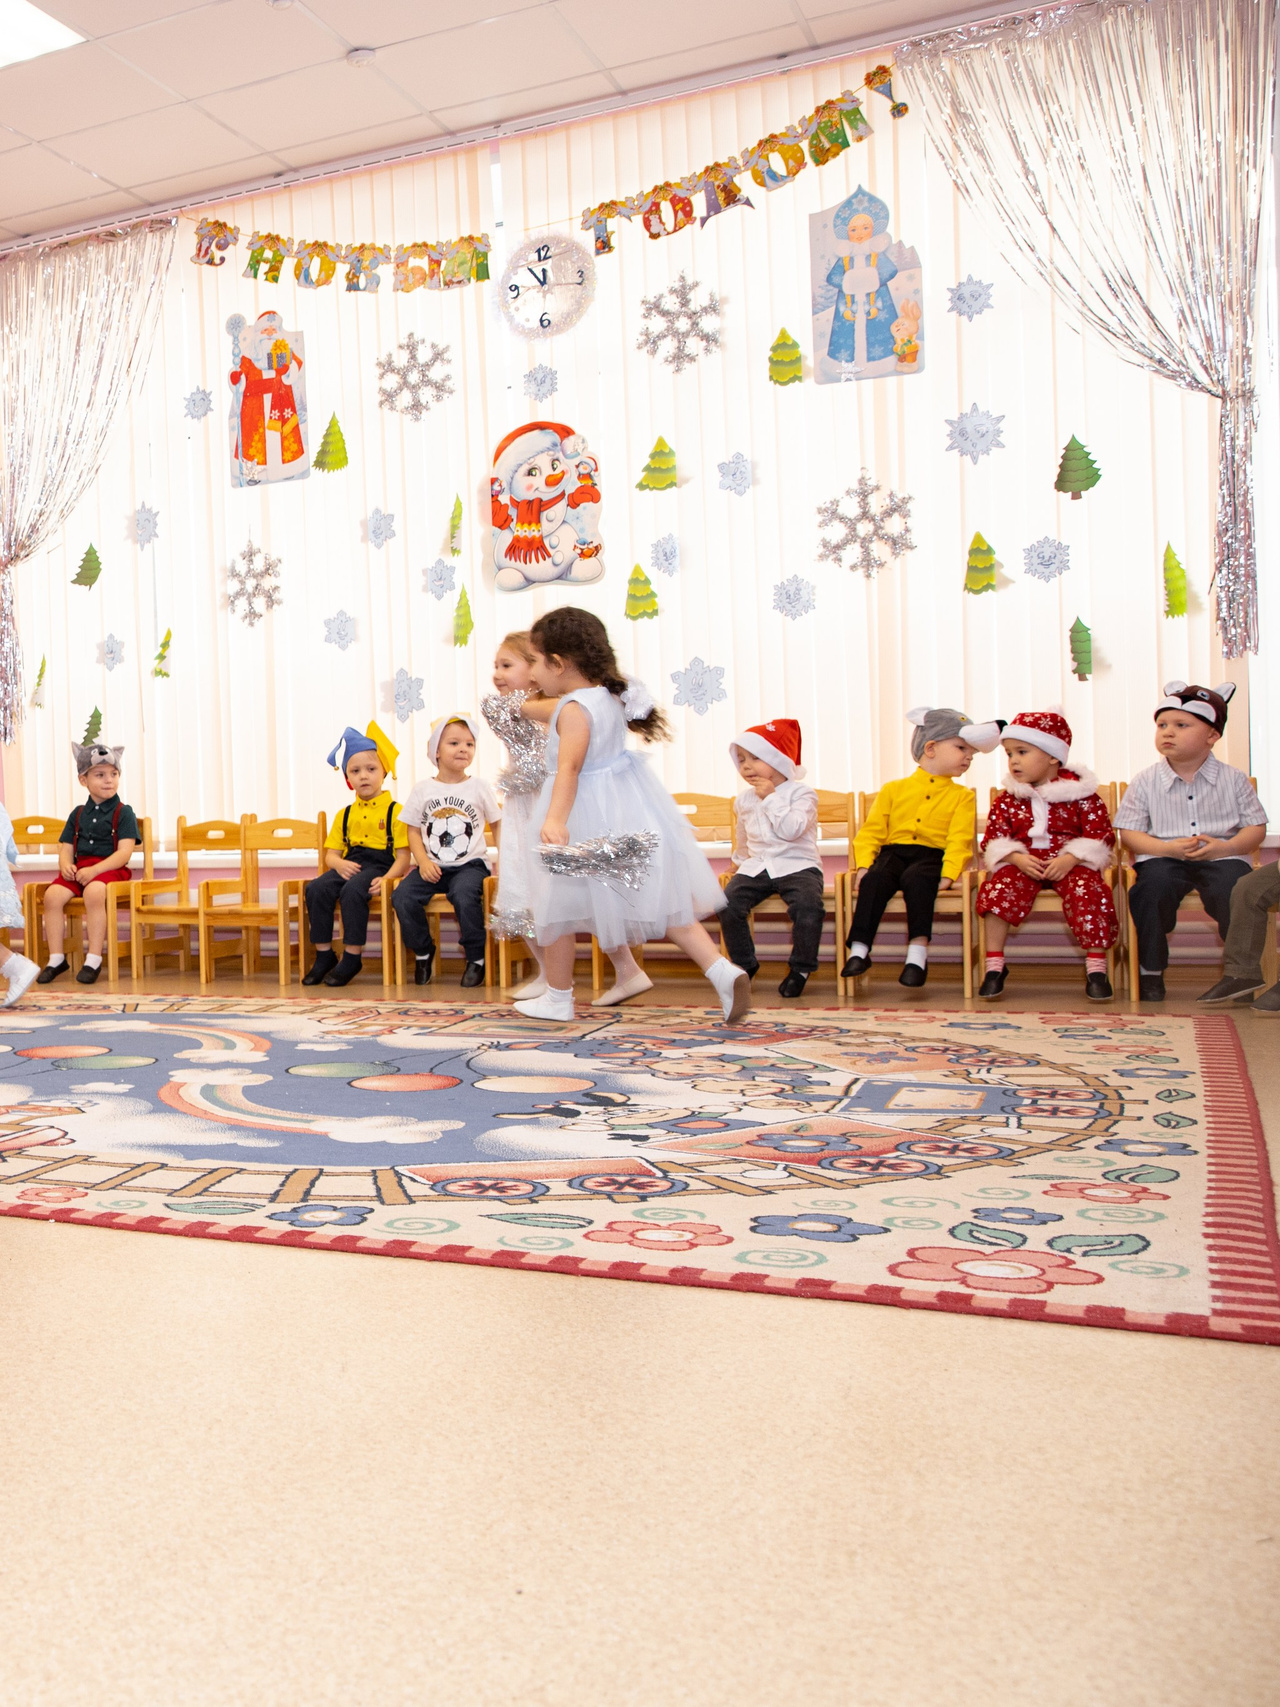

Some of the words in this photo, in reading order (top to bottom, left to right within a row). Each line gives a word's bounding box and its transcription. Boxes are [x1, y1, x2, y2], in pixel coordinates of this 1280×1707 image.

[535, 244, 552, 262] 12
[576, 269, 585, 285] 3
[508, 284, 520, 300] 9
[539, 311, 551, 328] 6
[444, 796, 465, 809] YOUR
[464, 804, 479, 830] GOALS
